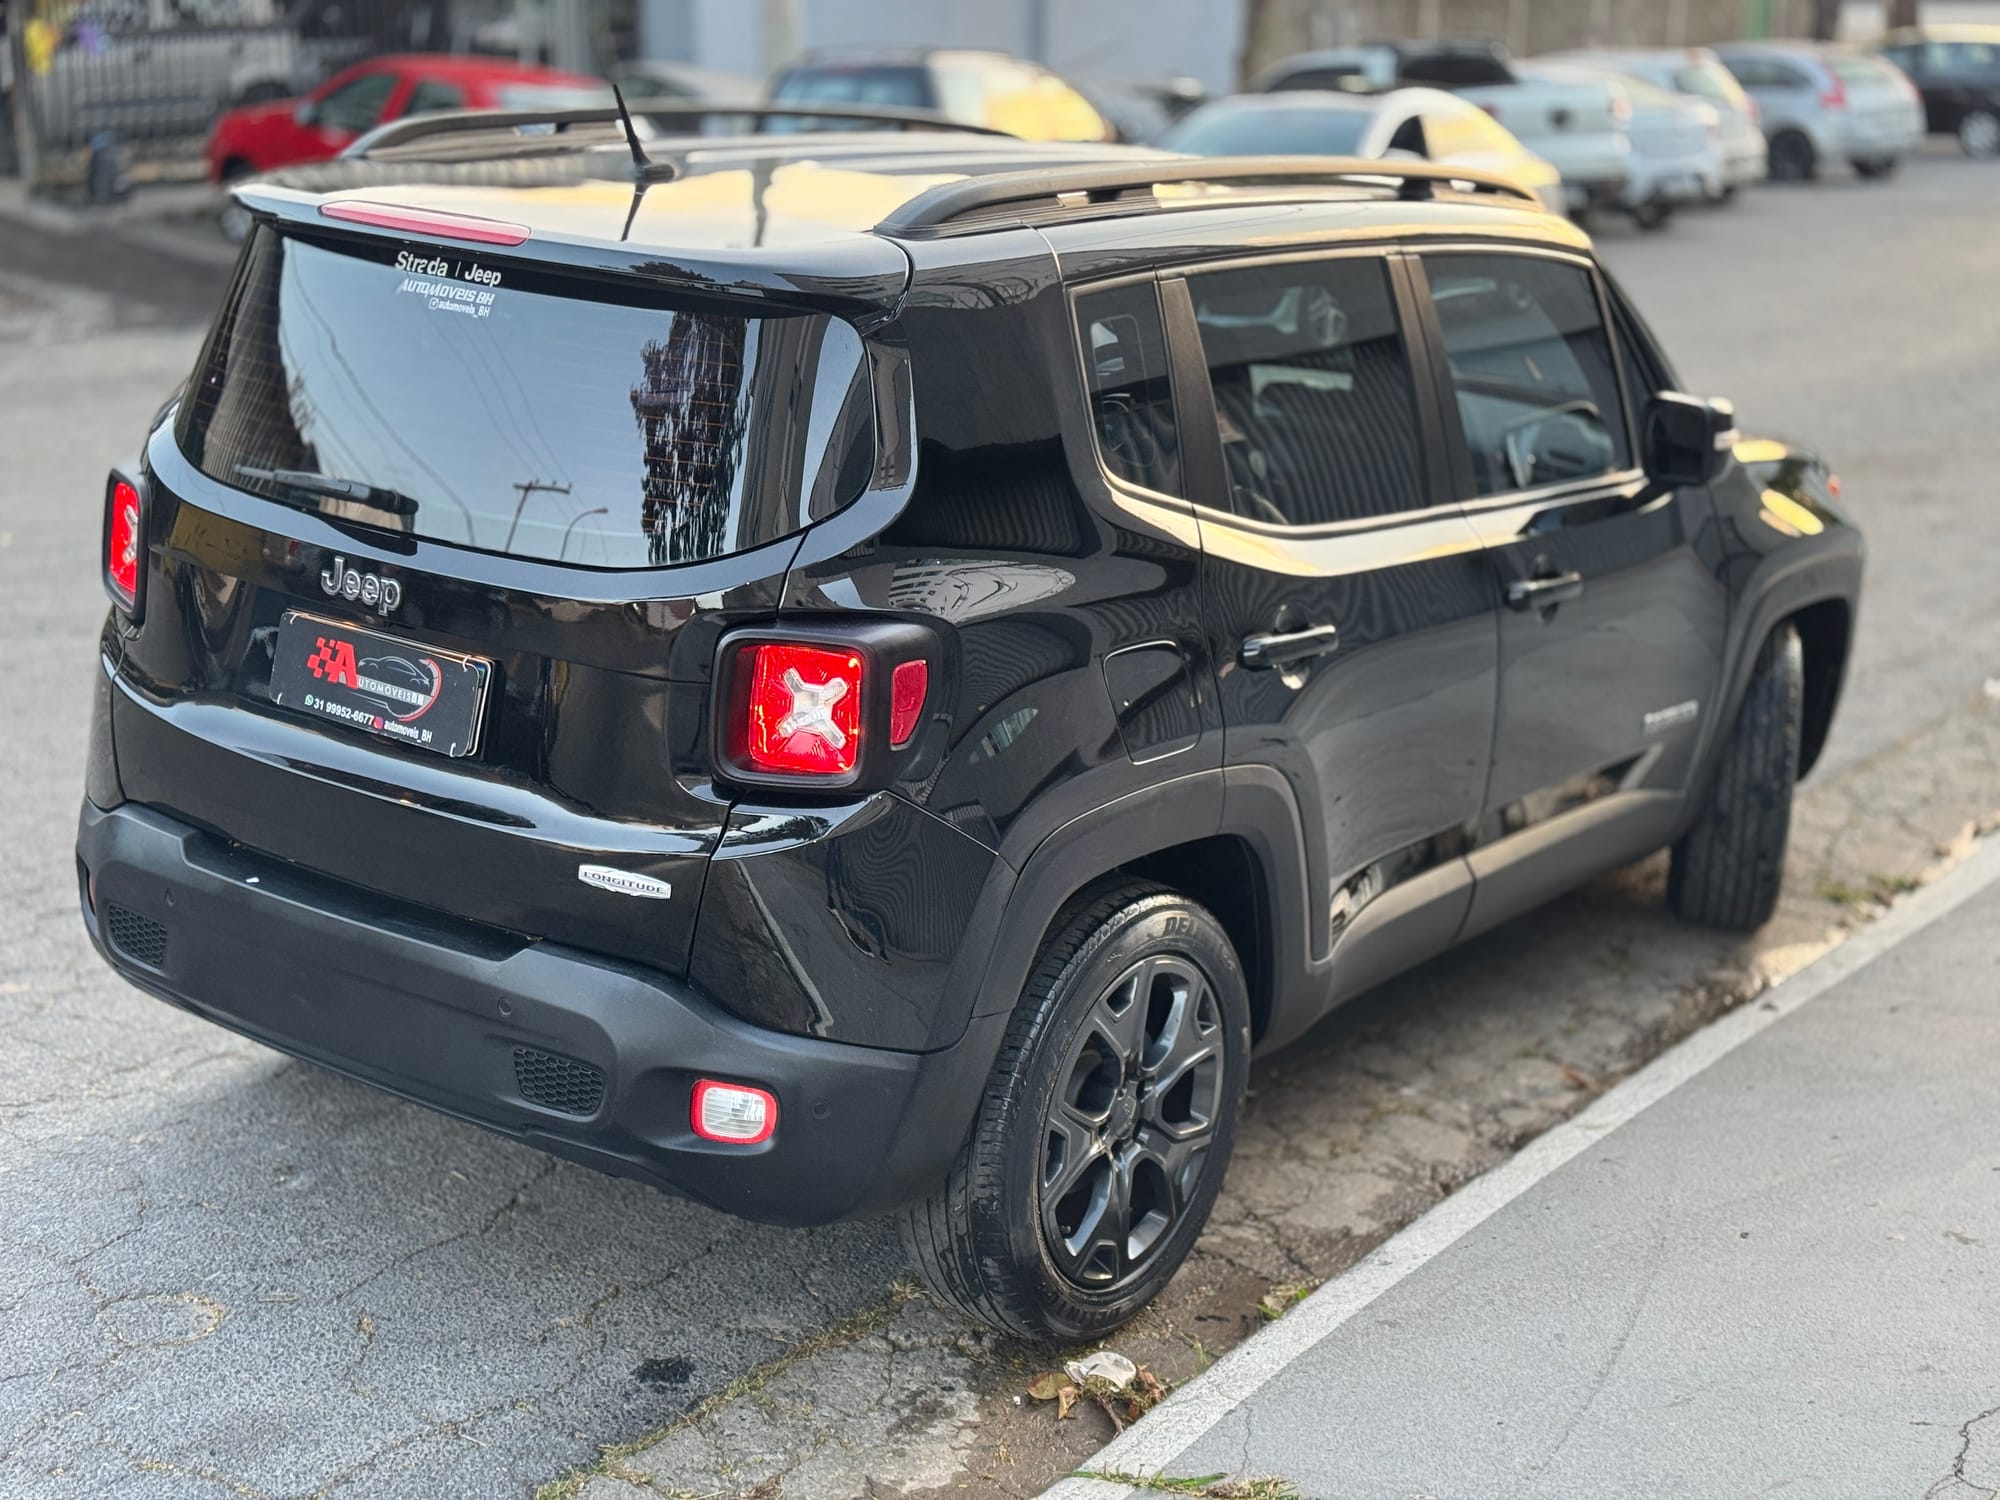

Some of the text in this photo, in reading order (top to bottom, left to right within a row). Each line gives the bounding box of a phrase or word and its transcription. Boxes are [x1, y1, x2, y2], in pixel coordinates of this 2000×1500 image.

[465, 264, 501, 287] Jeep
[321, 556, 402, 616] Jeep
[314, 698, 325, 710] 31
[583, 871, 664, 893] LONGITUDE
